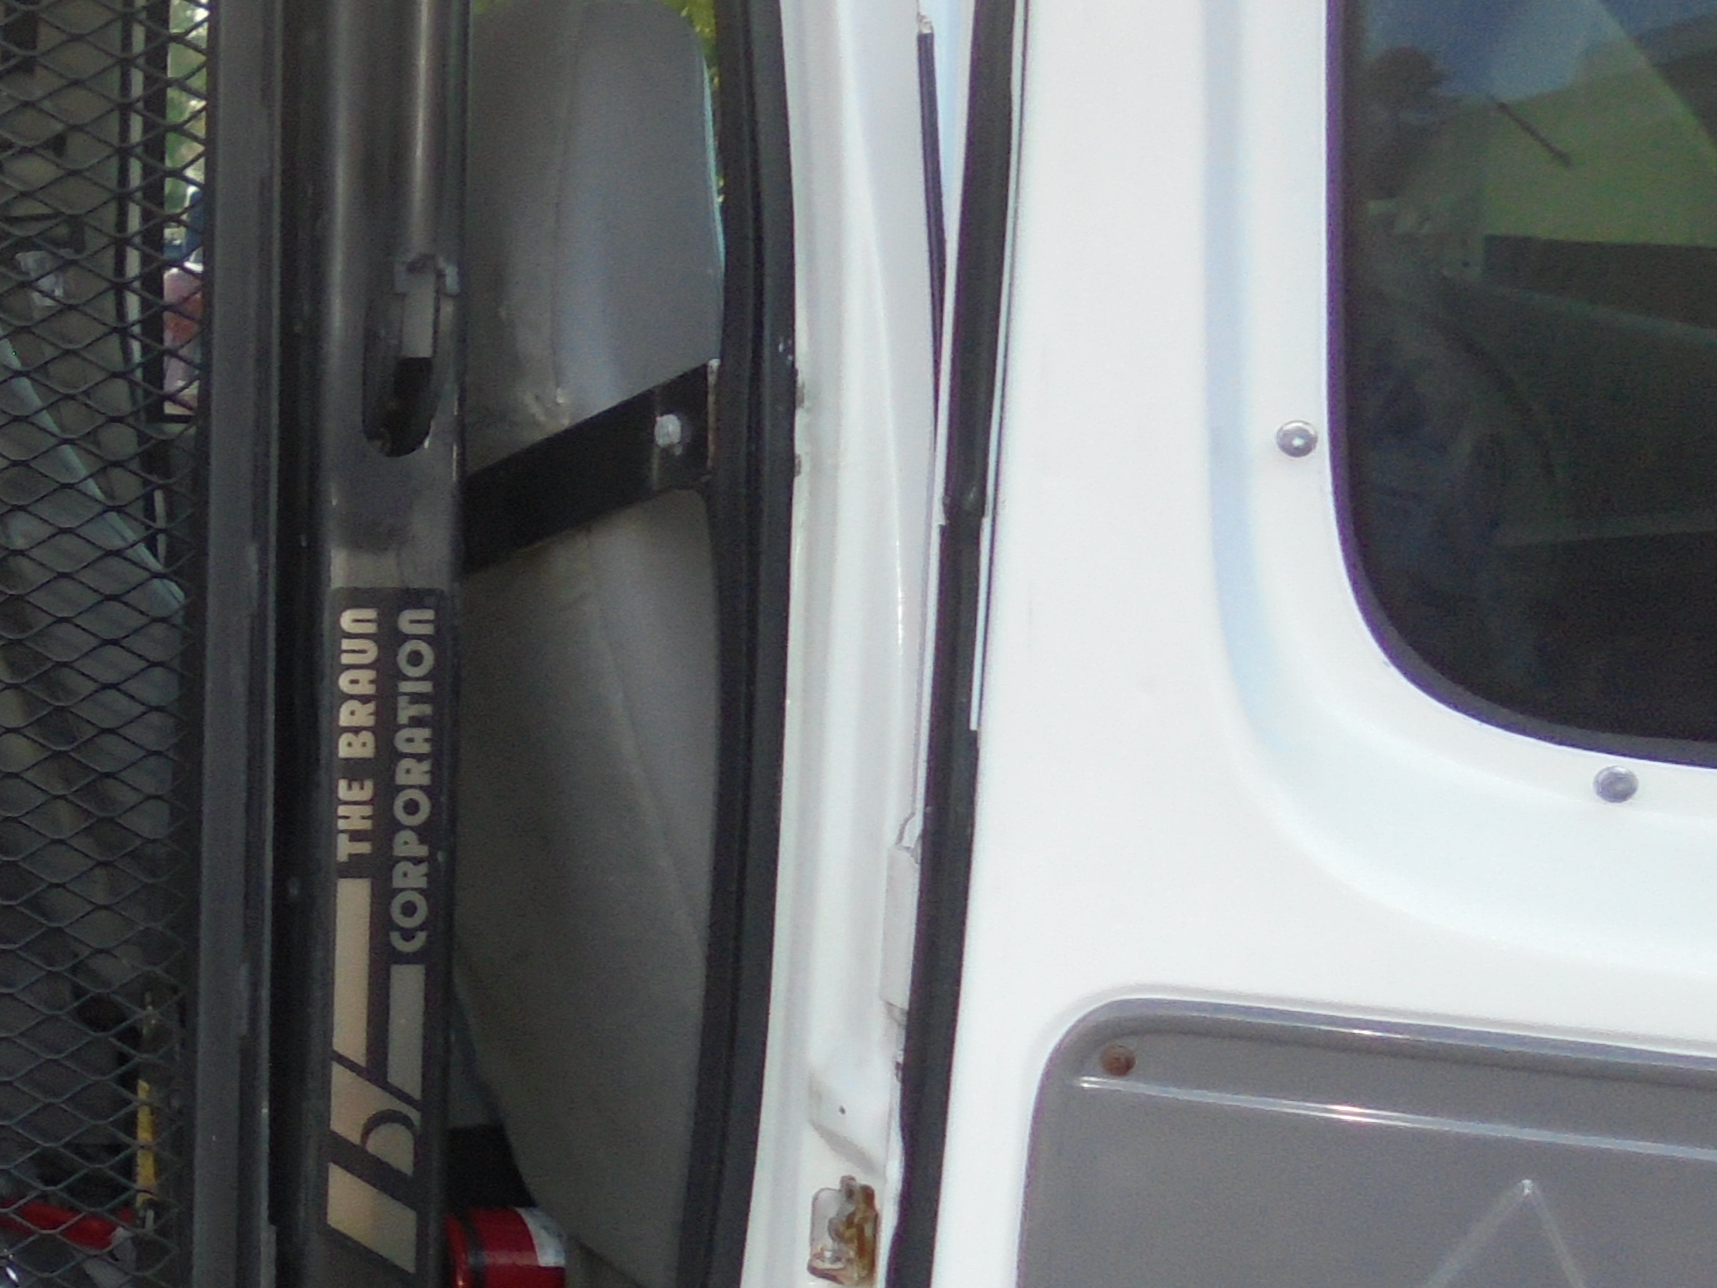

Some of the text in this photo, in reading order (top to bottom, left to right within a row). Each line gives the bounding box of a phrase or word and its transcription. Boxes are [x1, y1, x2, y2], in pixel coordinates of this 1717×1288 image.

[336, 607, 379, 862] THE BRAUN
[388, 608, 436, 954] CORPORATION
